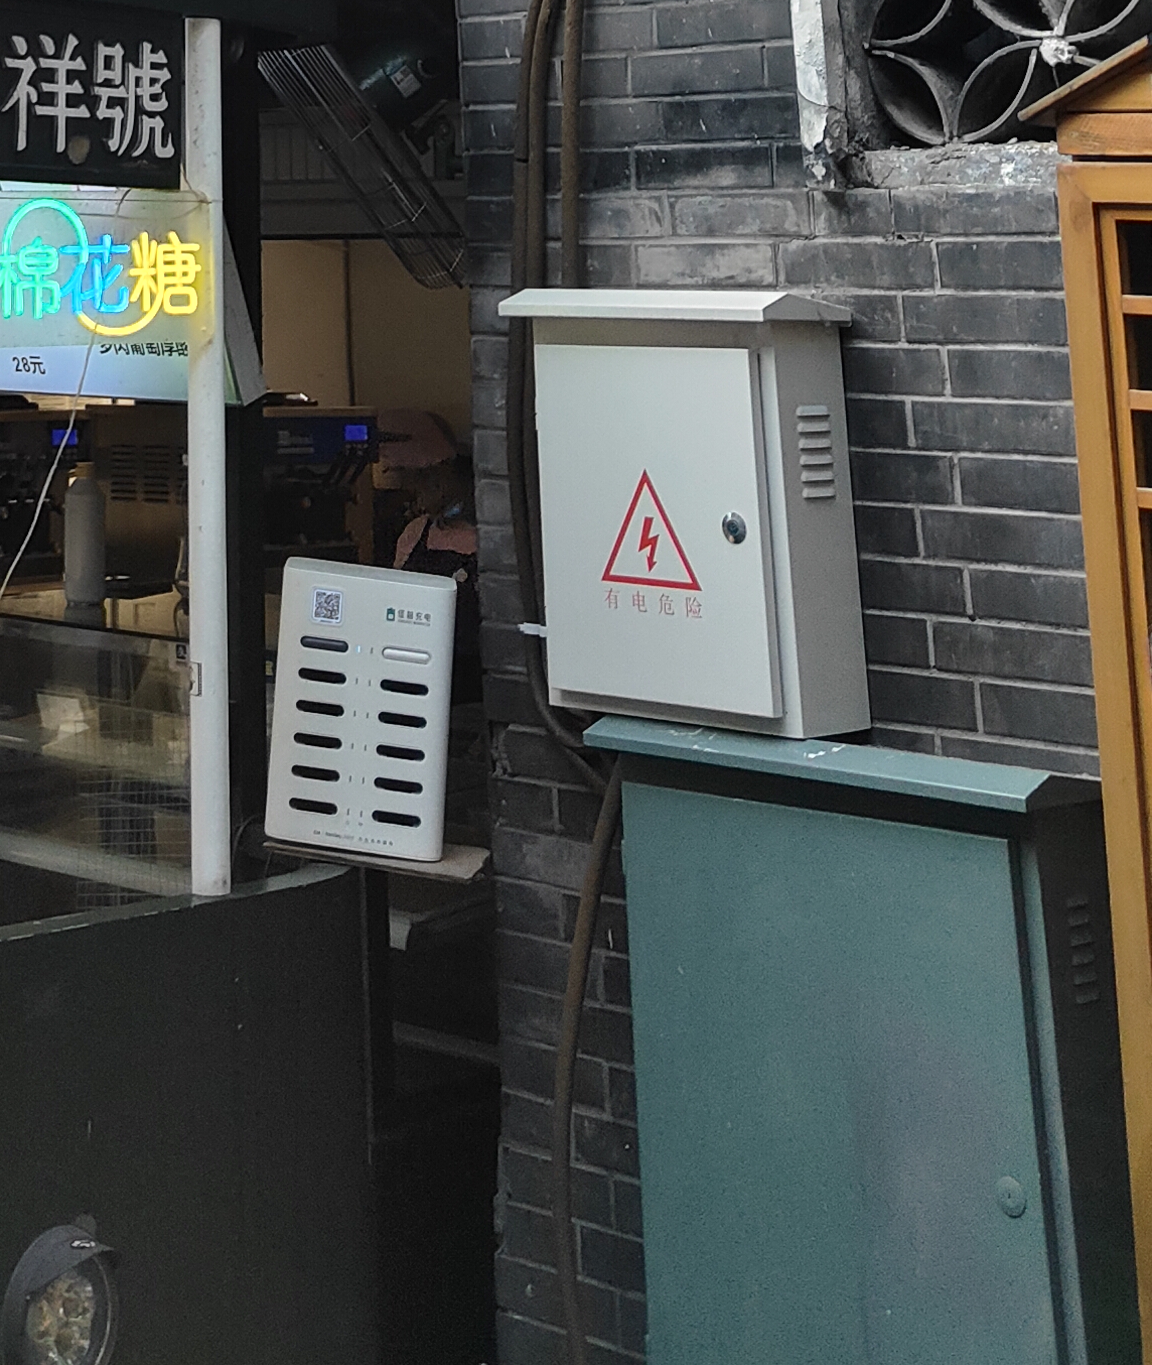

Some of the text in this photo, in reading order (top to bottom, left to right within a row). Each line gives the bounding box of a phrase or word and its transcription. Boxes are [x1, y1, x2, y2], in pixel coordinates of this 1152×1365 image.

[12, 355, 47, 376] 28元
[604, 588, 703, 619] 有电危险
